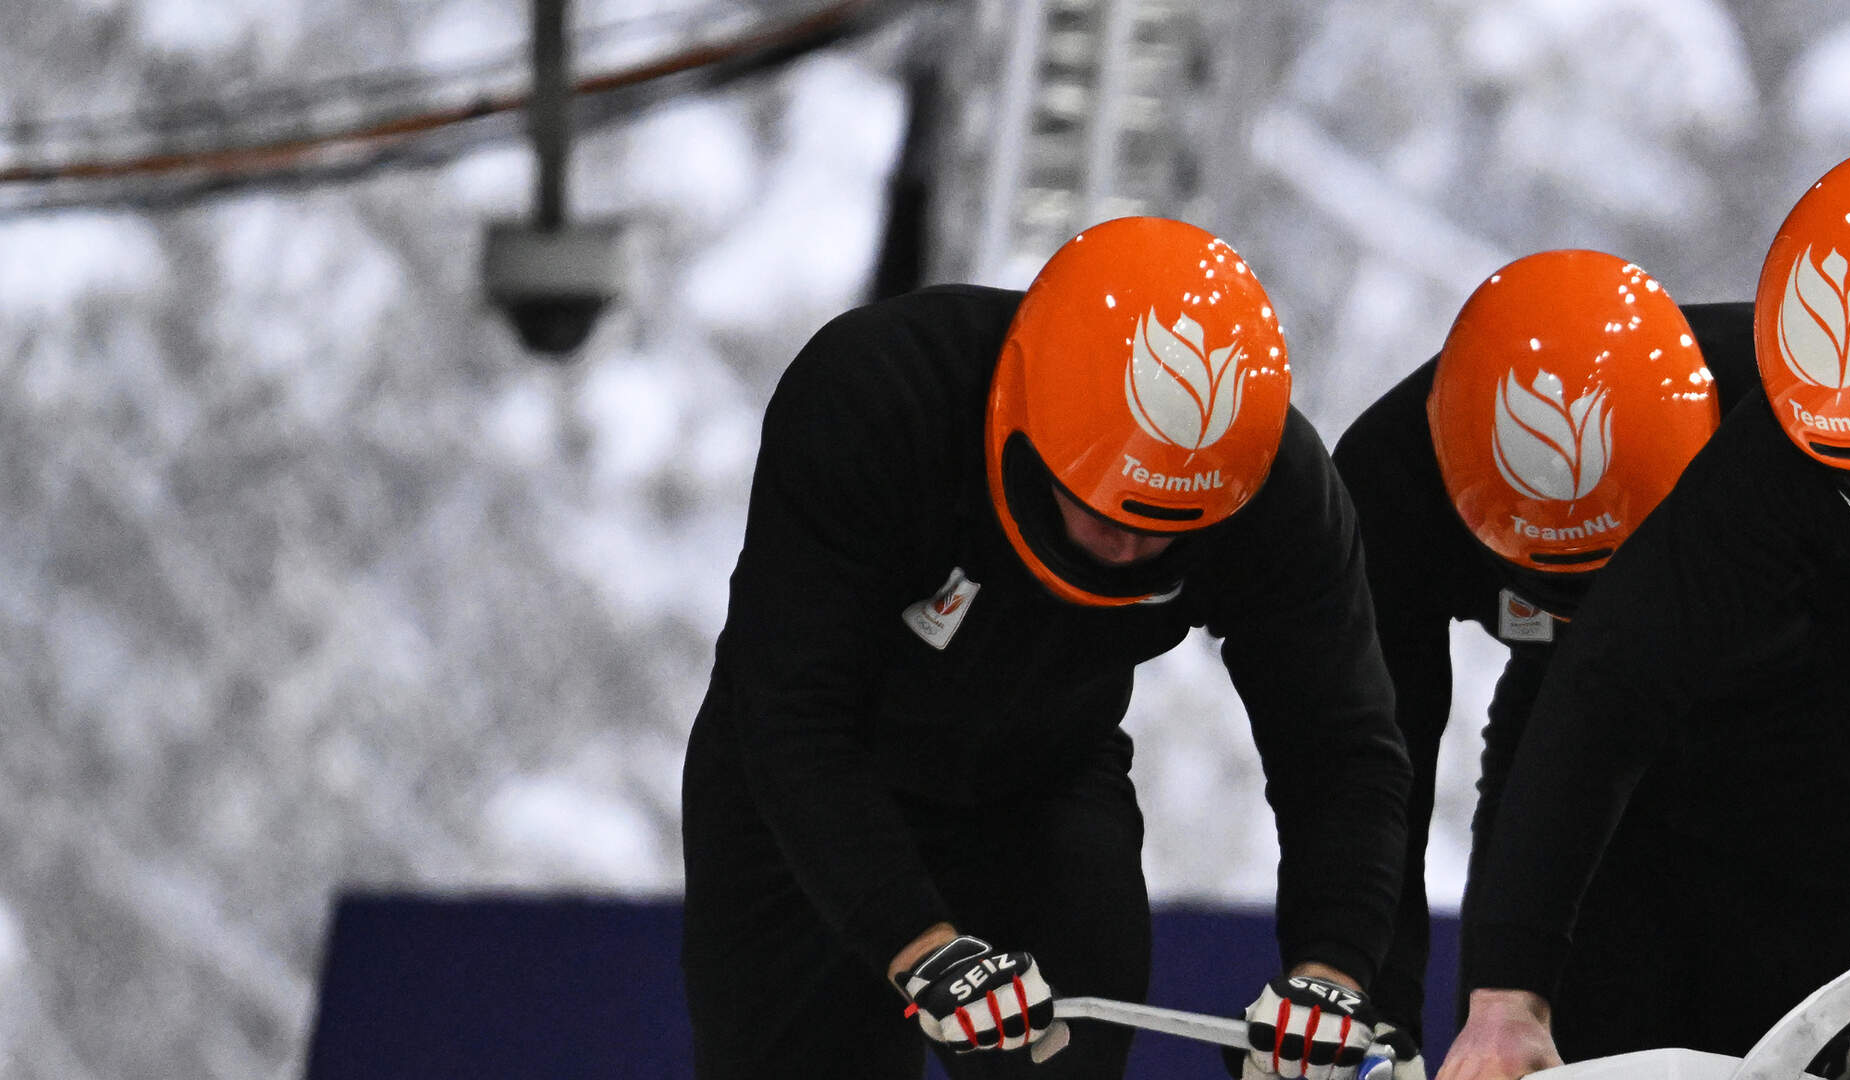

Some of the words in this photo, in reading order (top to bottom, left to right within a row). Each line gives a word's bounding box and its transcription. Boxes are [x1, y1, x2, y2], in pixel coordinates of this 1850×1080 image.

[1122, 453, 1224, 492] TeamNL
[1509, 512, 1621, 541] TeamNL
[949, 953, 1017, 1001] SEIZ
[1288, 977, 1362, 1015] SEIZ
